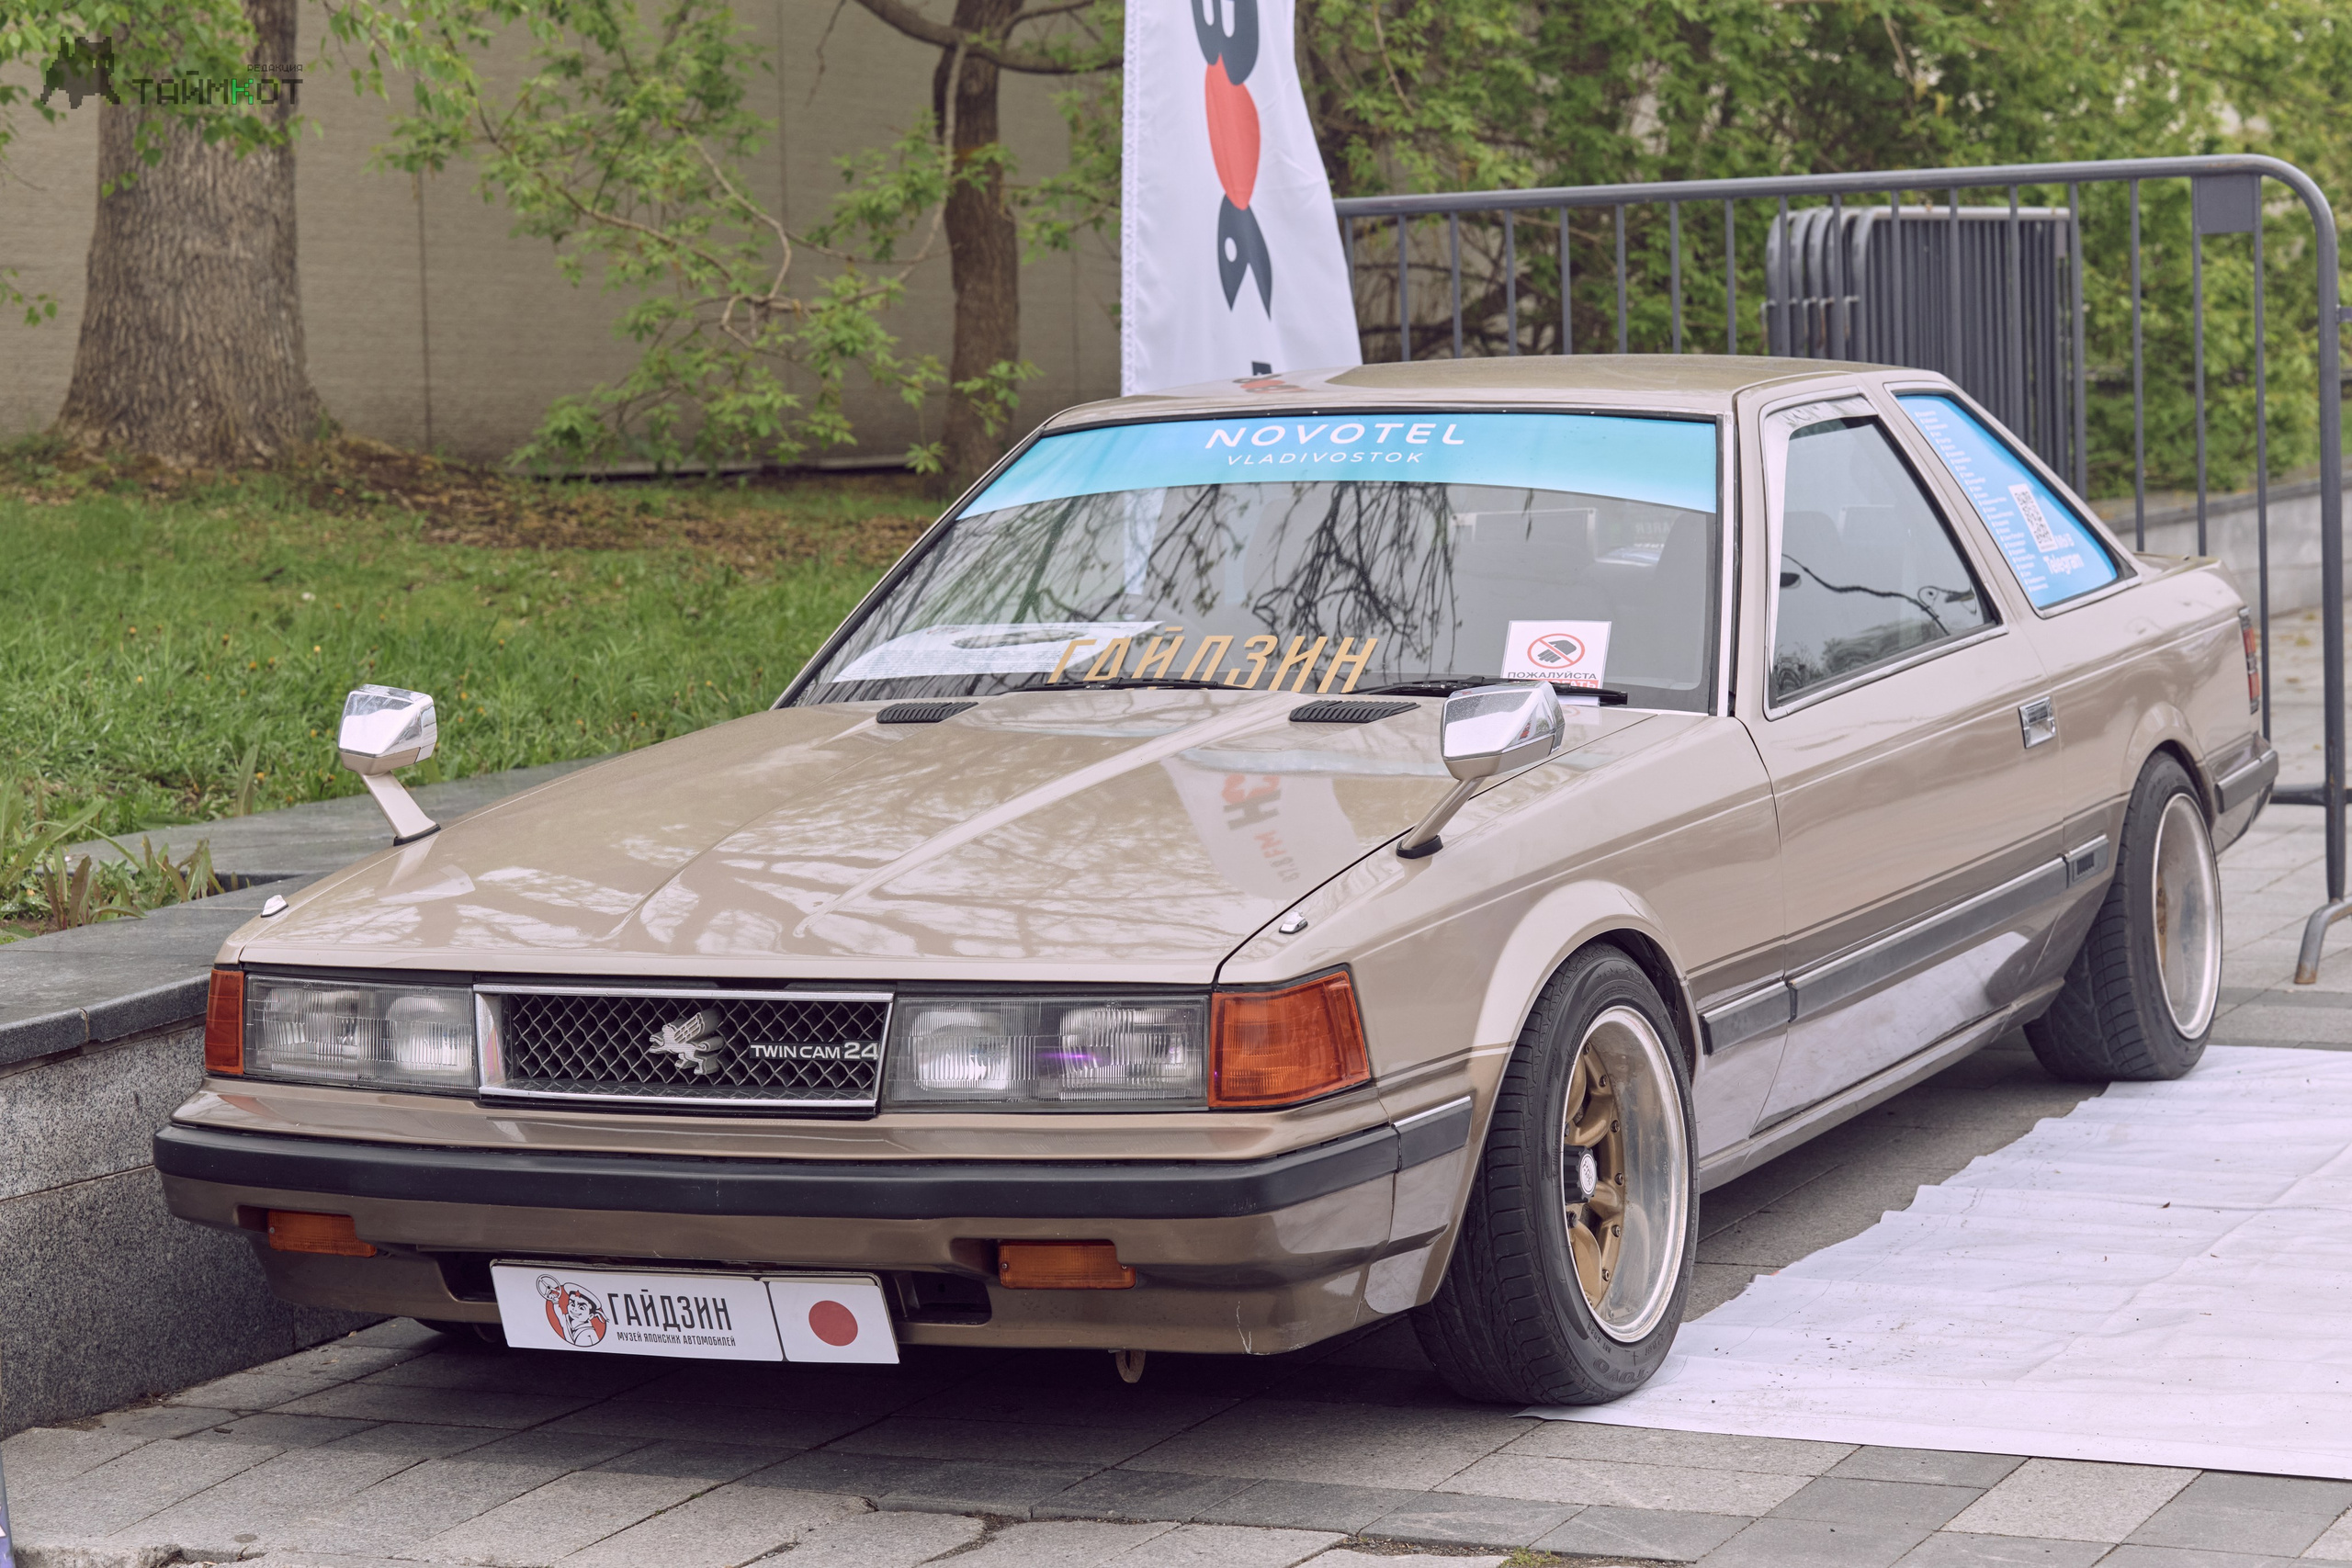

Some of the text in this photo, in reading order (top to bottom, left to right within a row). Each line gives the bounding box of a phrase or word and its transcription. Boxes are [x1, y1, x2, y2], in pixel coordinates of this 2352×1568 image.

[1205, 423, 1464, 449] NOVOTEL
[1227, 452, 1424, 466] VLADIVOSTOK
[2042, 553, 2085, 575] Telegram
[1508, 671, 1597, 680] ПОЖАЛУЙСТА
[750, 1042, 879, 1061] TWIN CAM 24
[607, 1289, 732, 1333] ГАЙДЗИН
[616, 1331, 736, 1347] МУЗЕЙ ЯПОНСКИХ АВТОМОБИЛЕЙ
